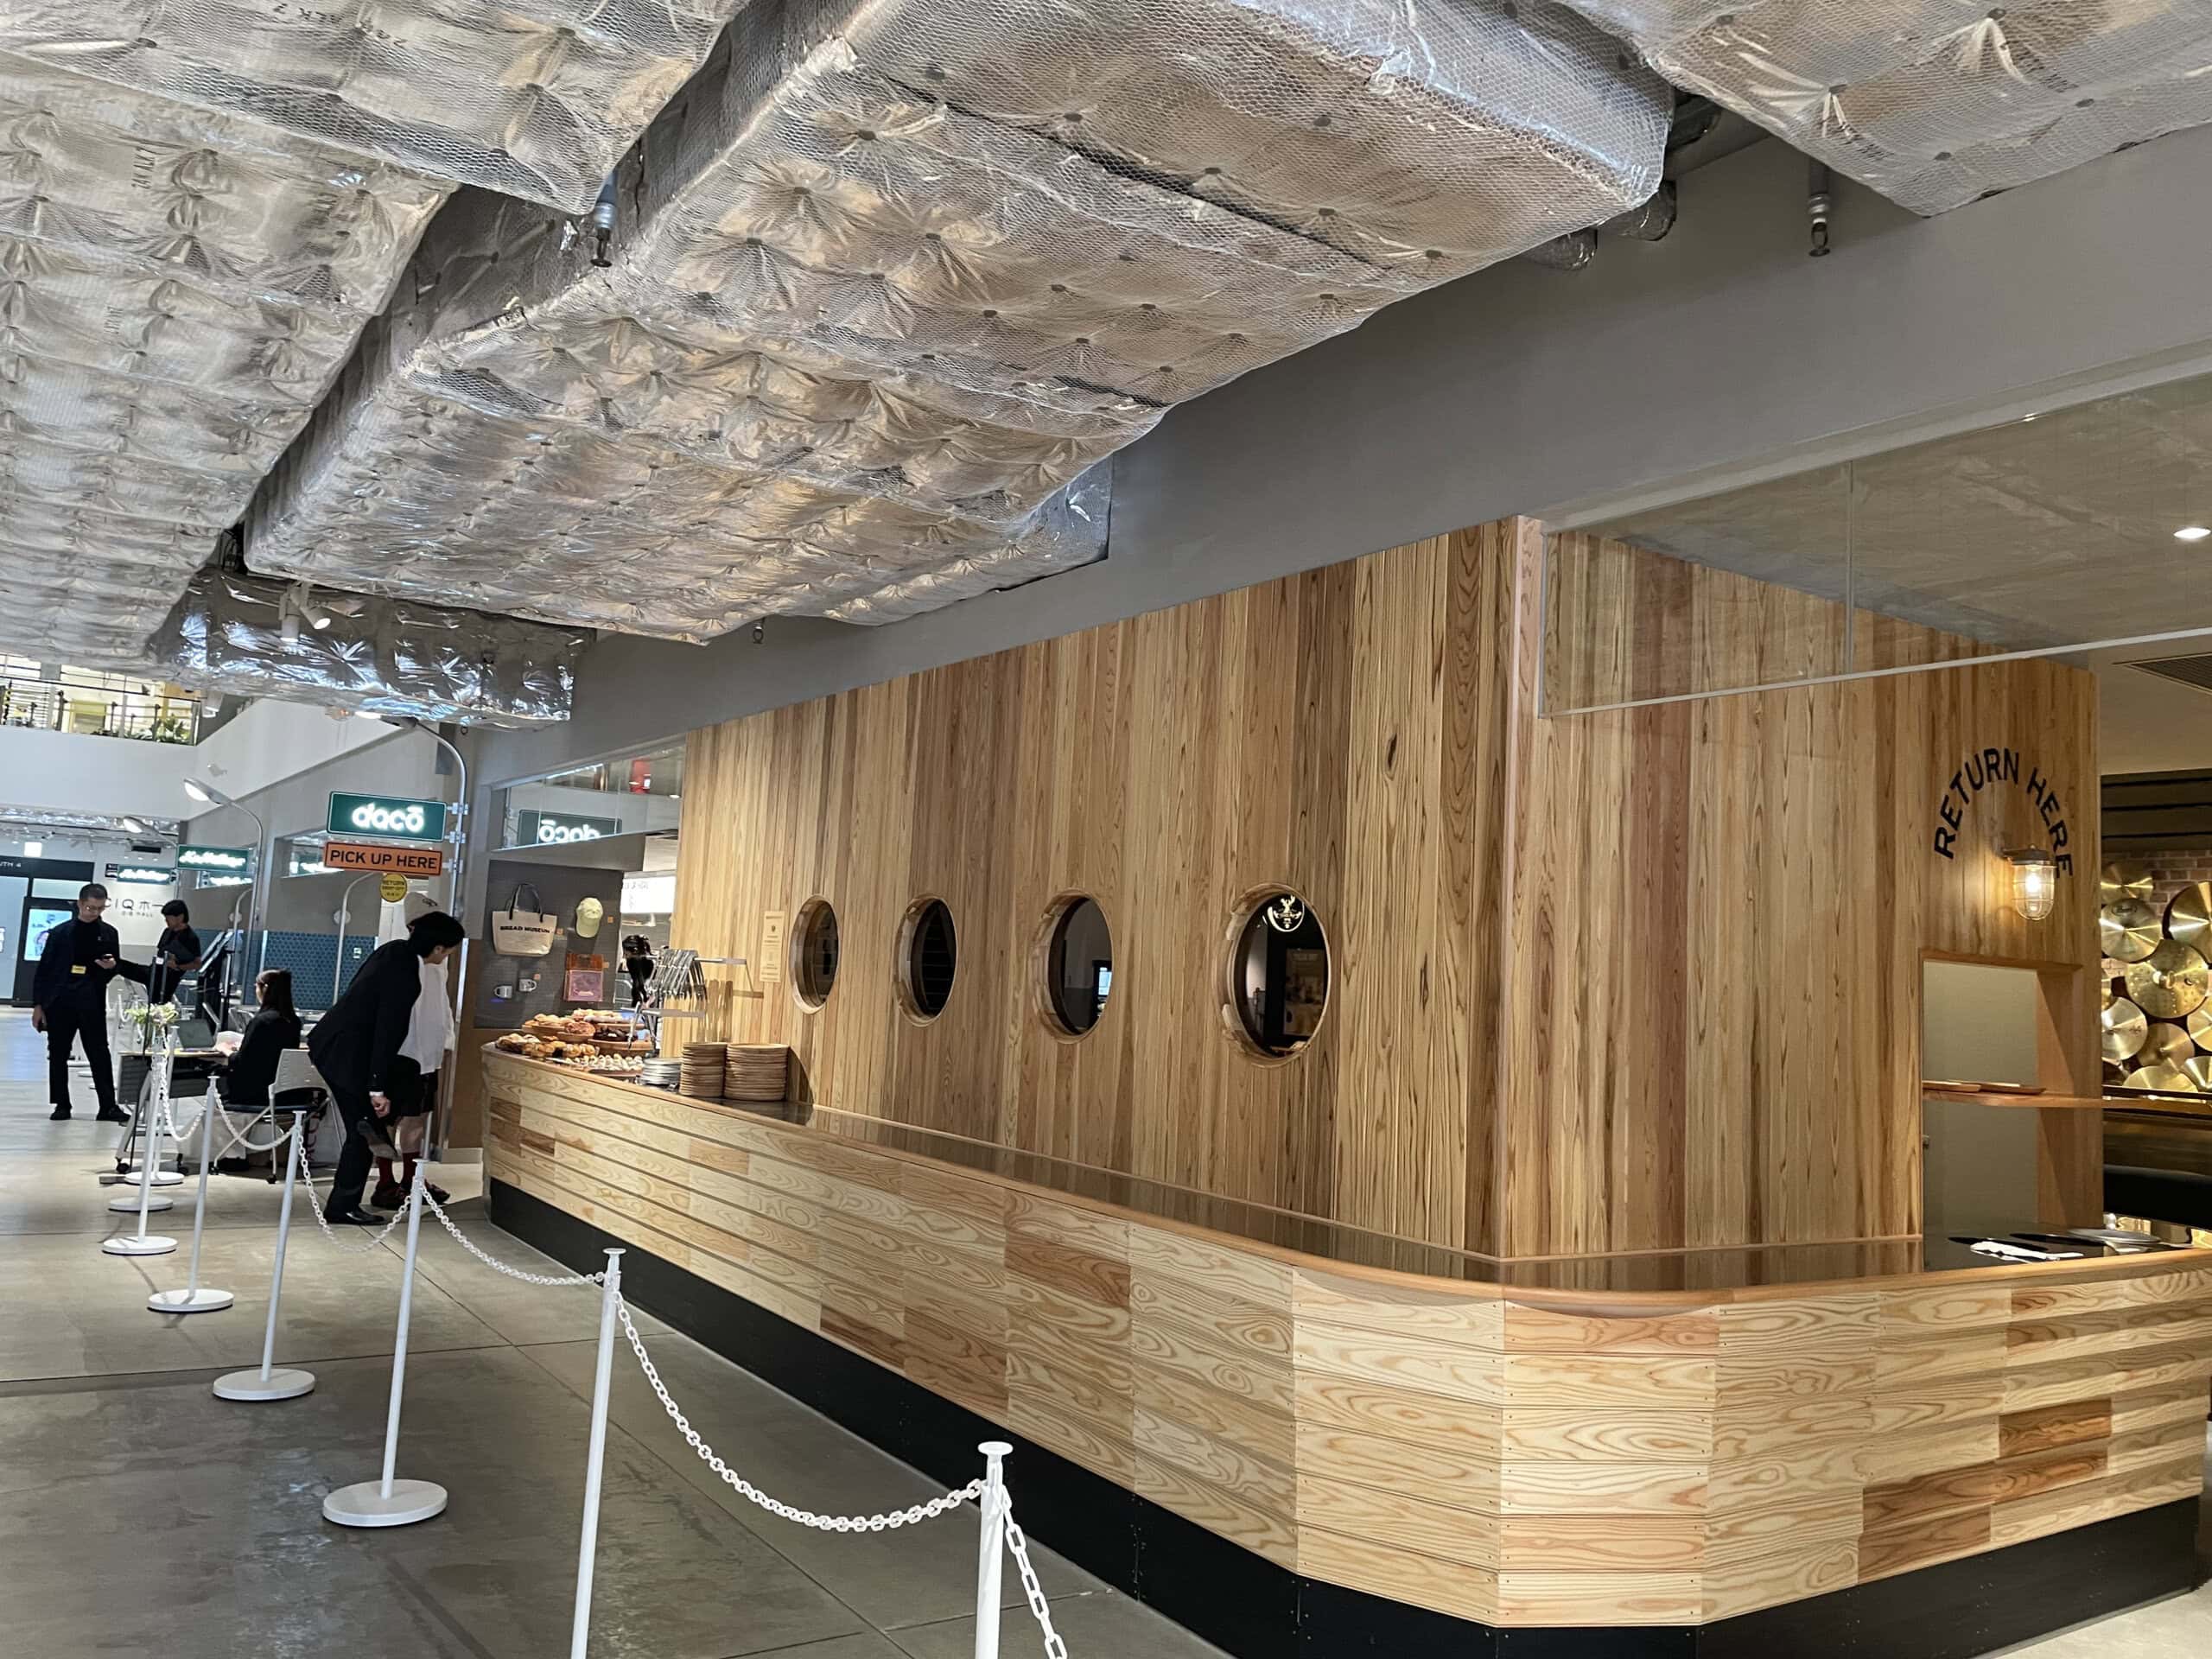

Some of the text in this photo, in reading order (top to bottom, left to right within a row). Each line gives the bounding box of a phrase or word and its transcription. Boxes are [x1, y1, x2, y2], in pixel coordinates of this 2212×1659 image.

[1934, 747, 2073, 879] RETURN HERE
[330, 849, 437, 868] PICK UP HERE
